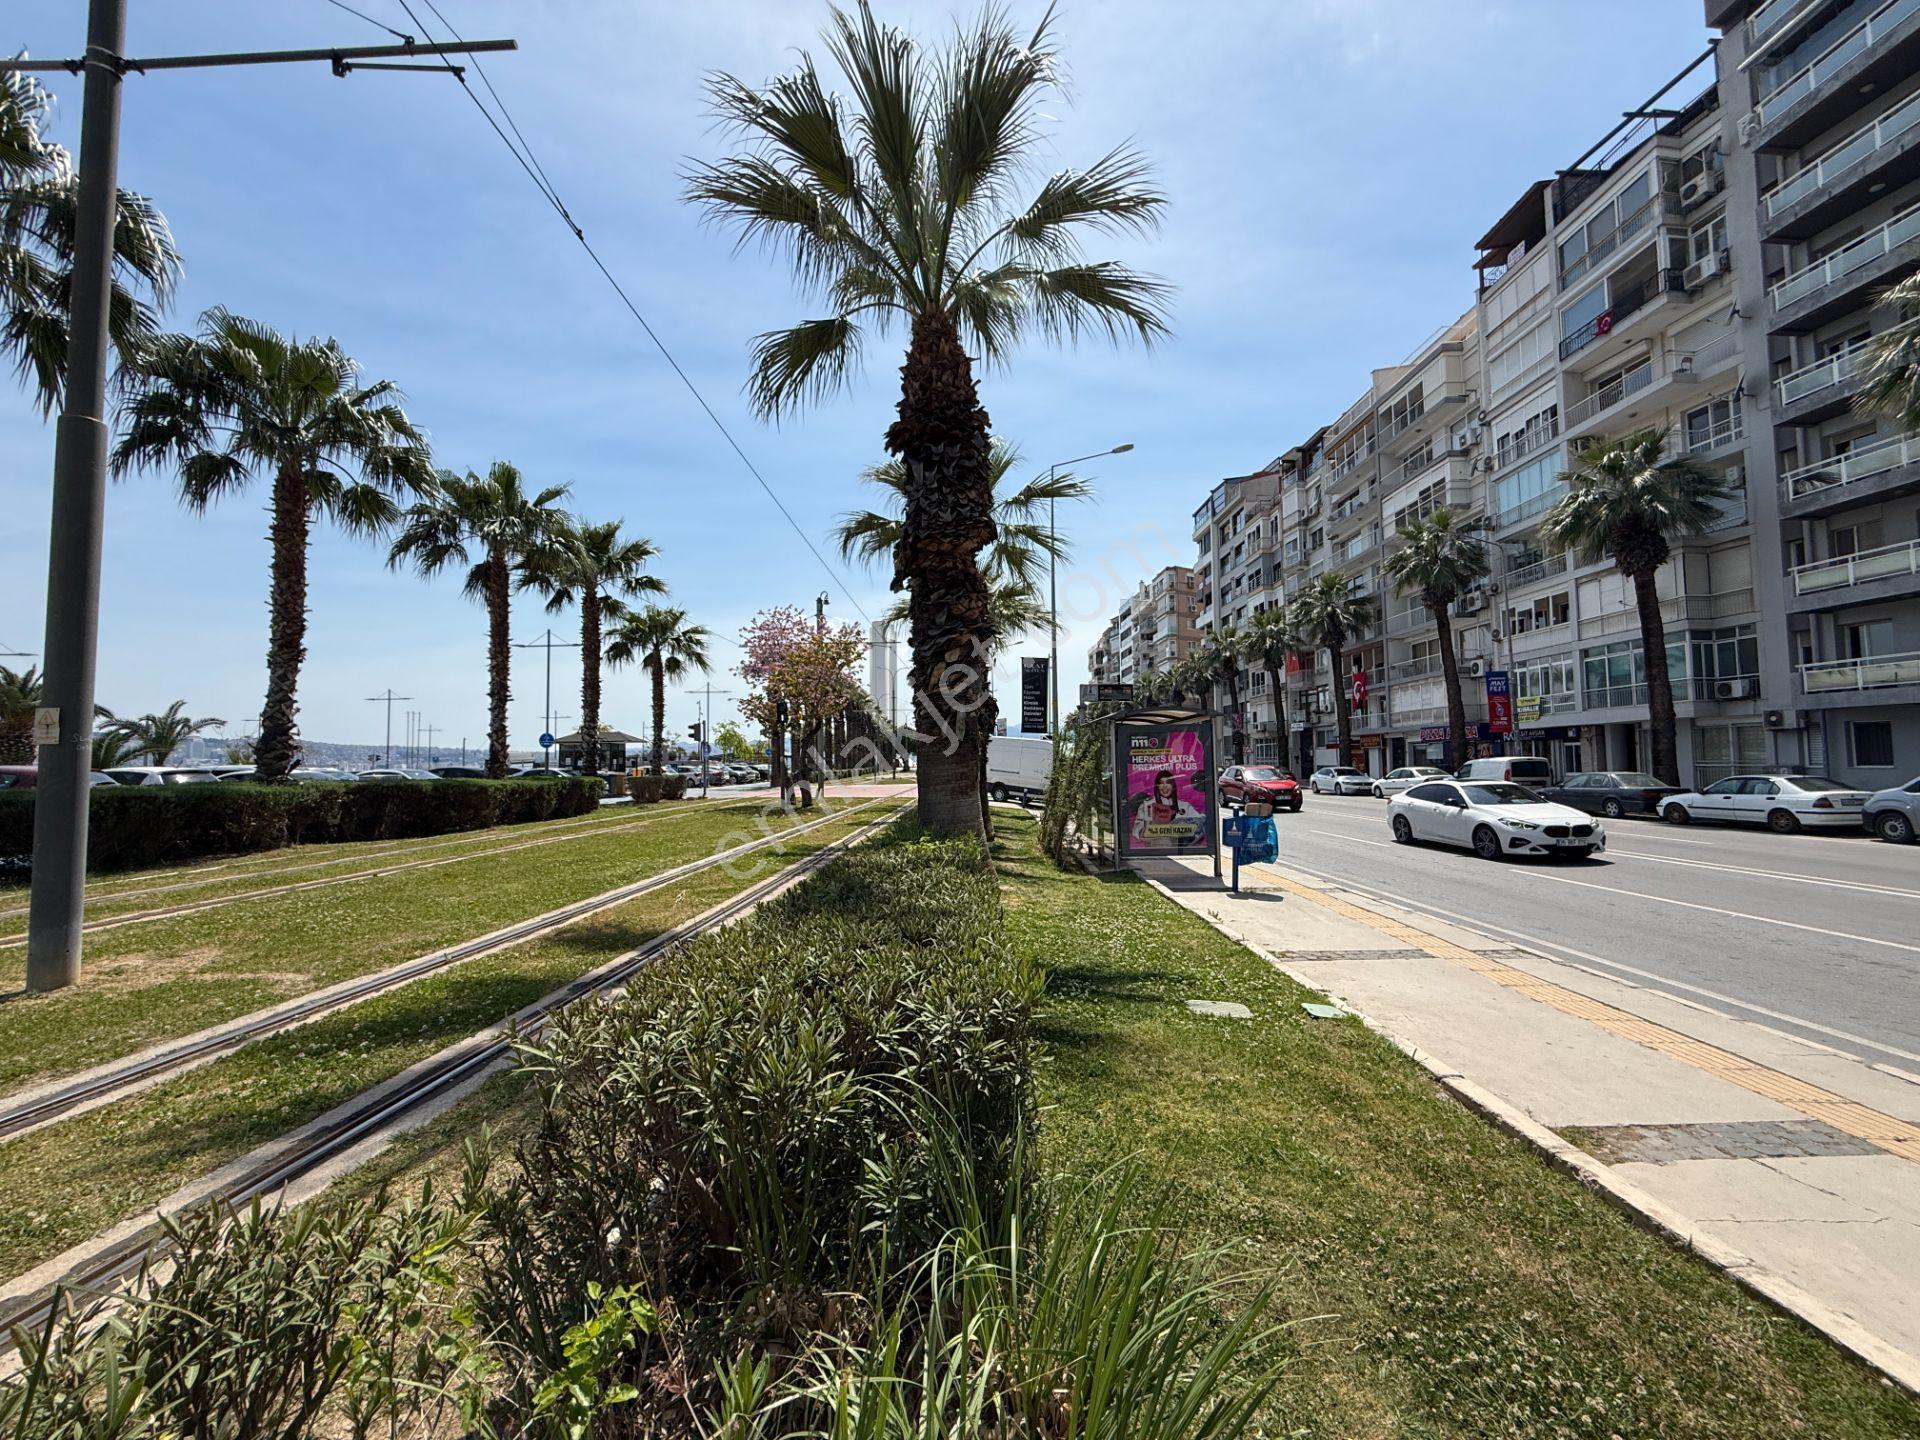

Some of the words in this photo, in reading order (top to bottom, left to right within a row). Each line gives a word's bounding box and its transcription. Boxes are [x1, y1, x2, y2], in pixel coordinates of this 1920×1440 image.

[1132, 755, 1167, 763] HERKES
[1168, 754, 1196, 763] ULTRA
[1132, 763, 1173, 771] PREMIUM
[1175, 762, 1198, 770] PLUS
